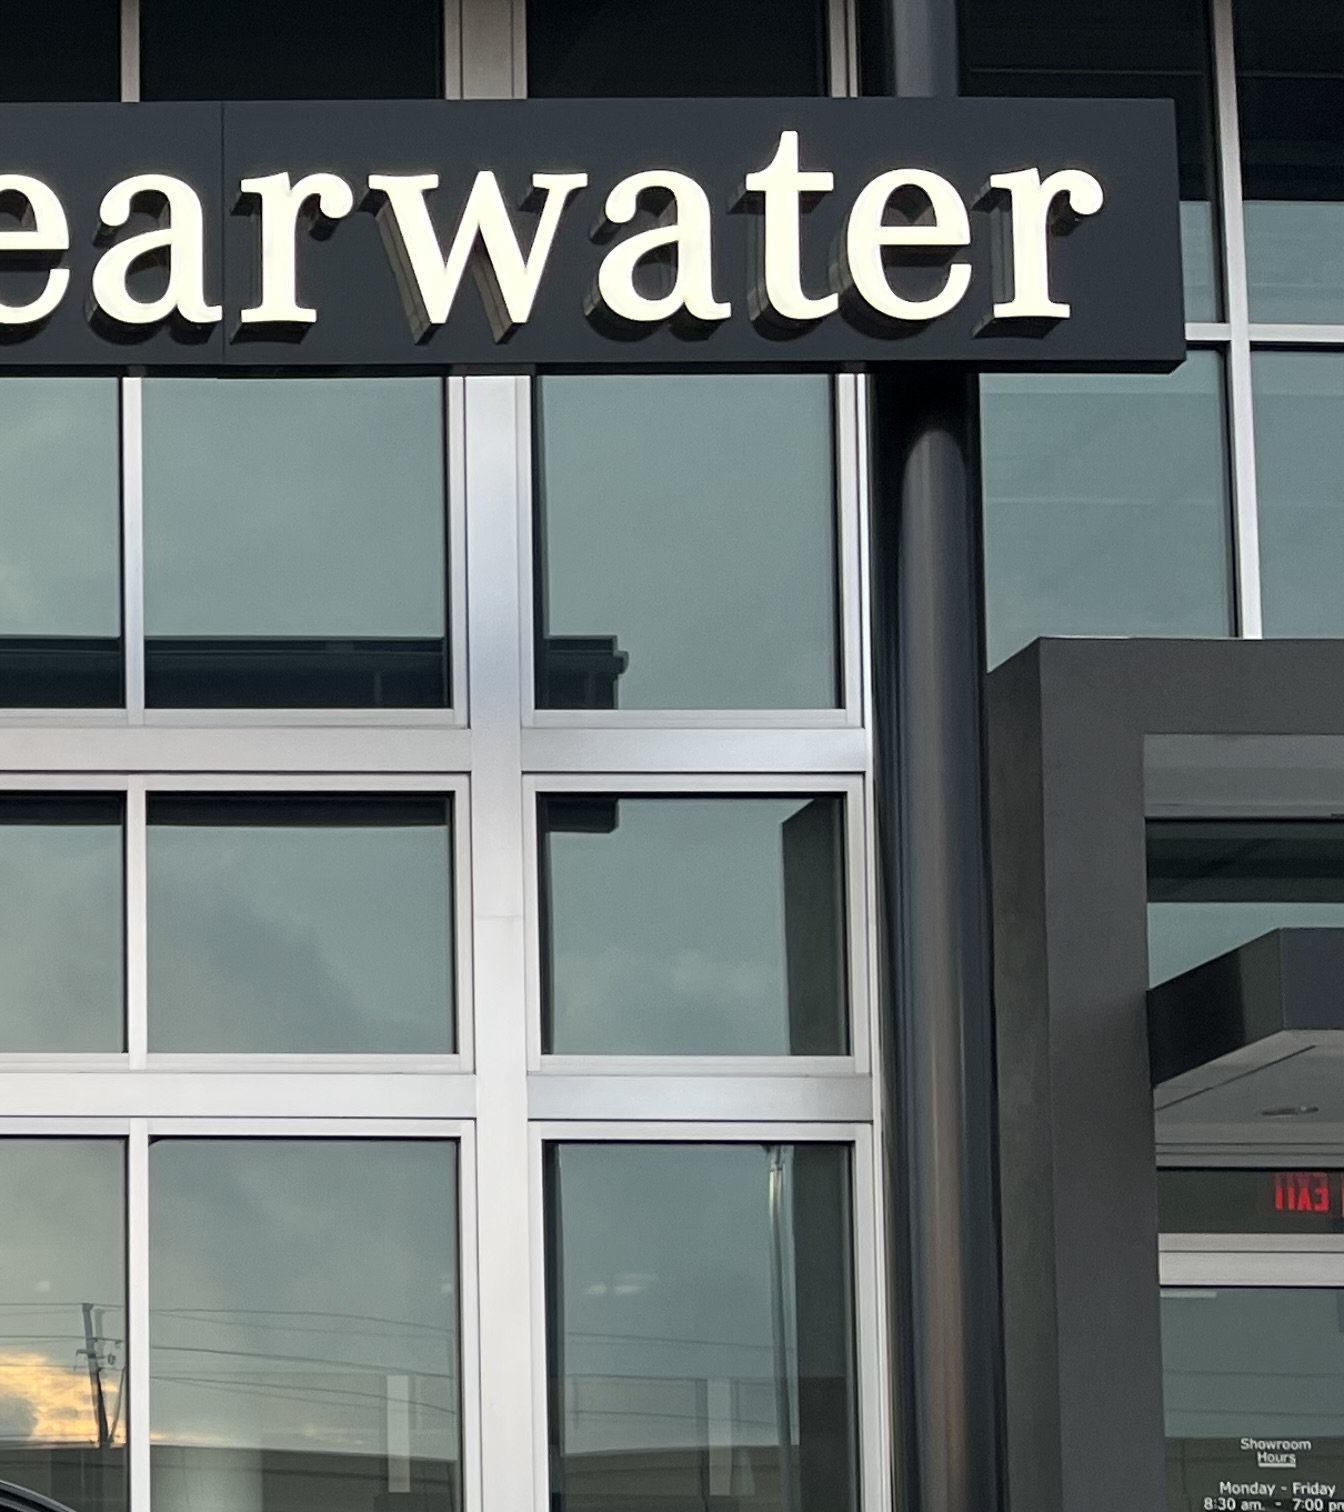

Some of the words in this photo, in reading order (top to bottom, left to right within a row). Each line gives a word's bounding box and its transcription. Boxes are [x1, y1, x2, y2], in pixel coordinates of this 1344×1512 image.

[1240, 1437, 1312, 1451] Showroom
[1257, 1451, 1297, 1464] Hours
[1219, 1481, 1276, 1497] Monday
[1292, 1481, 1337, 1499] Friday
[1203, 1497, 1237, 1511] 8:30
[1292, 1498, 1324, 1512] 7:00
